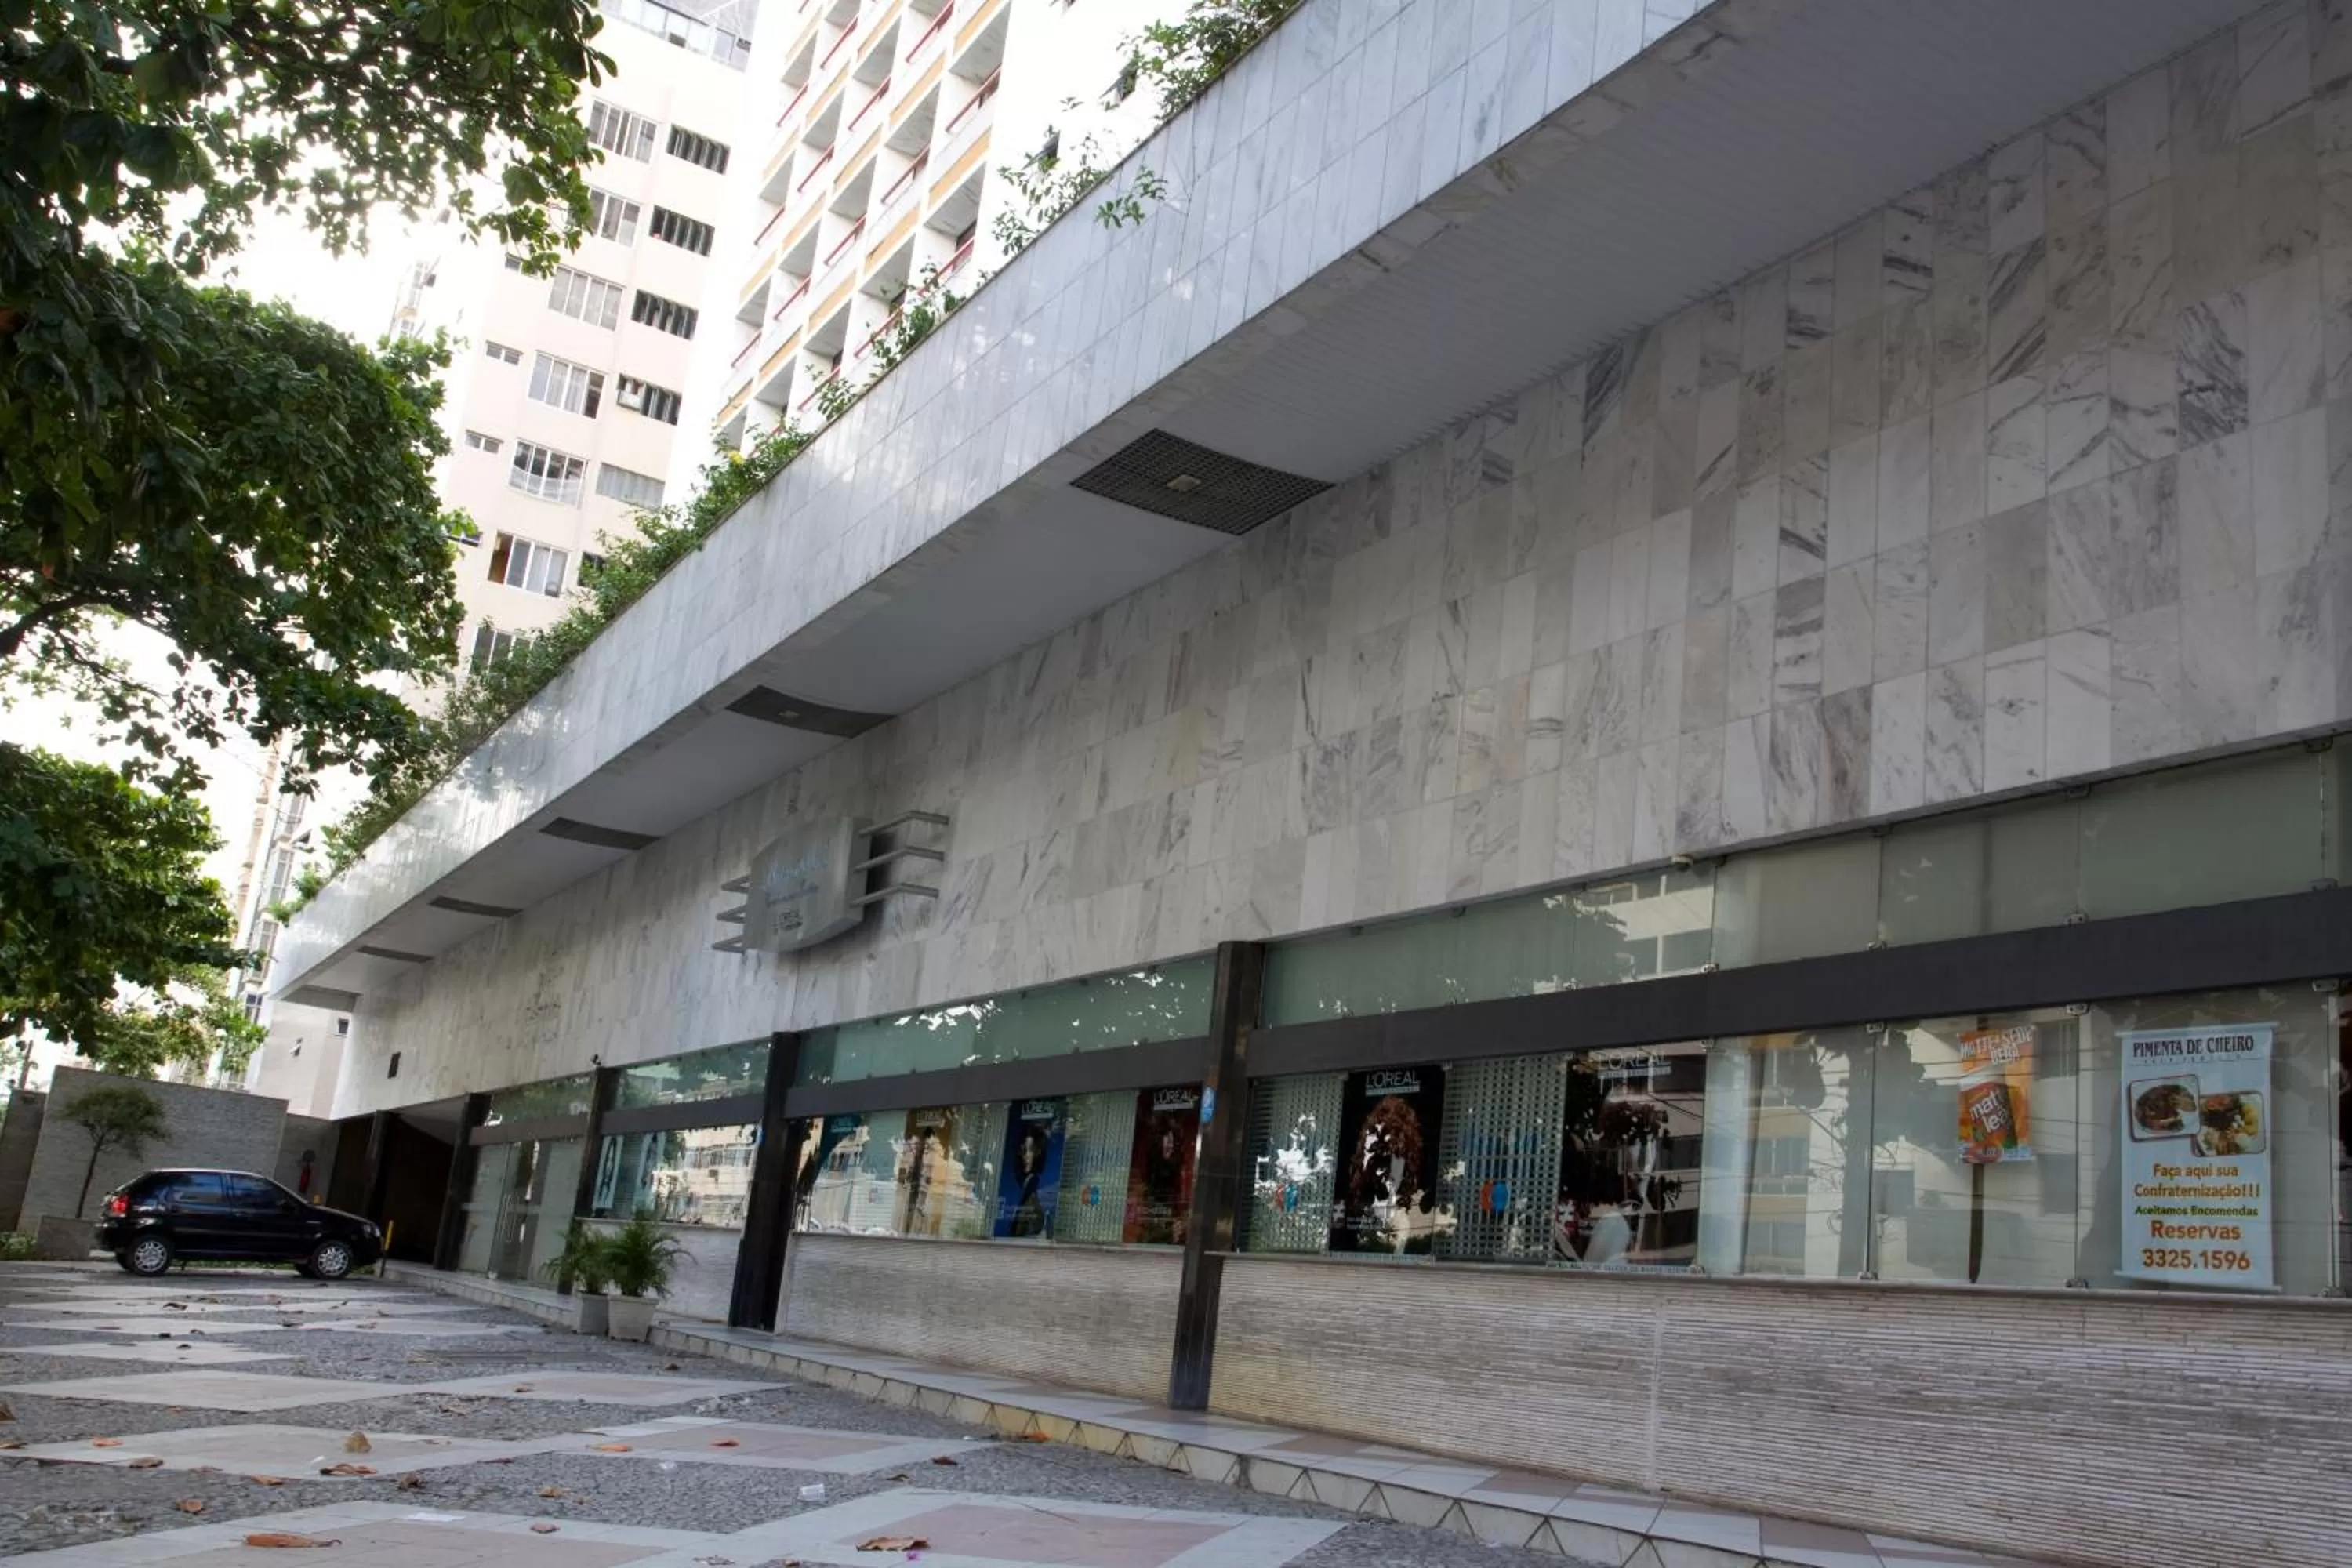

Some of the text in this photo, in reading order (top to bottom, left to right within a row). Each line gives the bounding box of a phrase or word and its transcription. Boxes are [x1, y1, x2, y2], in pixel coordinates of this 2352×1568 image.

[2133, 1035, 2254, 1058] PIMENTA DE CHEIRO
[2152, 1163, 2239, 1180] Faça aqui sua
[2134, 1182, 2260, 1200] Confraternização!!!
[2135, 1204, 2259, 1216] Aceitamos Encomendas
[2151, 1220, 2241, 1240] Reservas
[2142, 1249, 2251, 1270] 3325.1596
